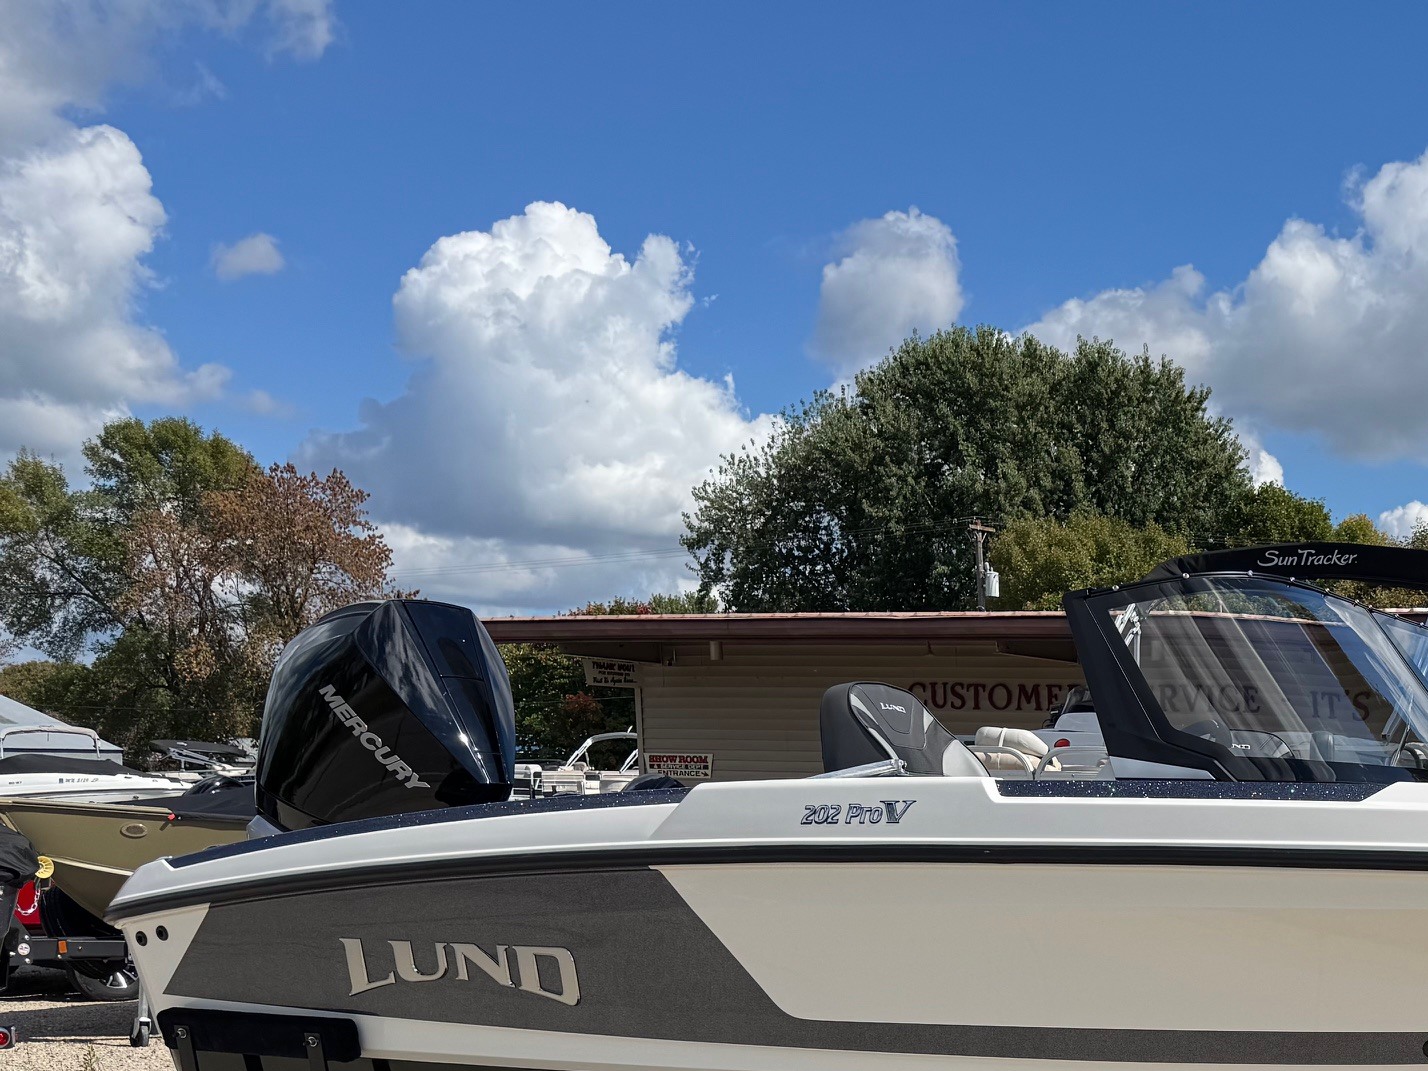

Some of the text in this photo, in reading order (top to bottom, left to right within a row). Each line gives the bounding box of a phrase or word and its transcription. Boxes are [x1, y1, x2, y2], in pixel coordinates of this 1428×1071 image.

[592, 661, 616, 671] THANK
[907, 681, 1081, 712] CUSTOME
[880, 702, 906, 713] LUND
[318, 684, 431, 789] MERCURY
[649, 755, 708, 763] SHOW ROOM
[657, 769, 701, 777] ENTRANCE
[801, 804, 842, 825] 202
[338, 937, 581, 1006] LUND
